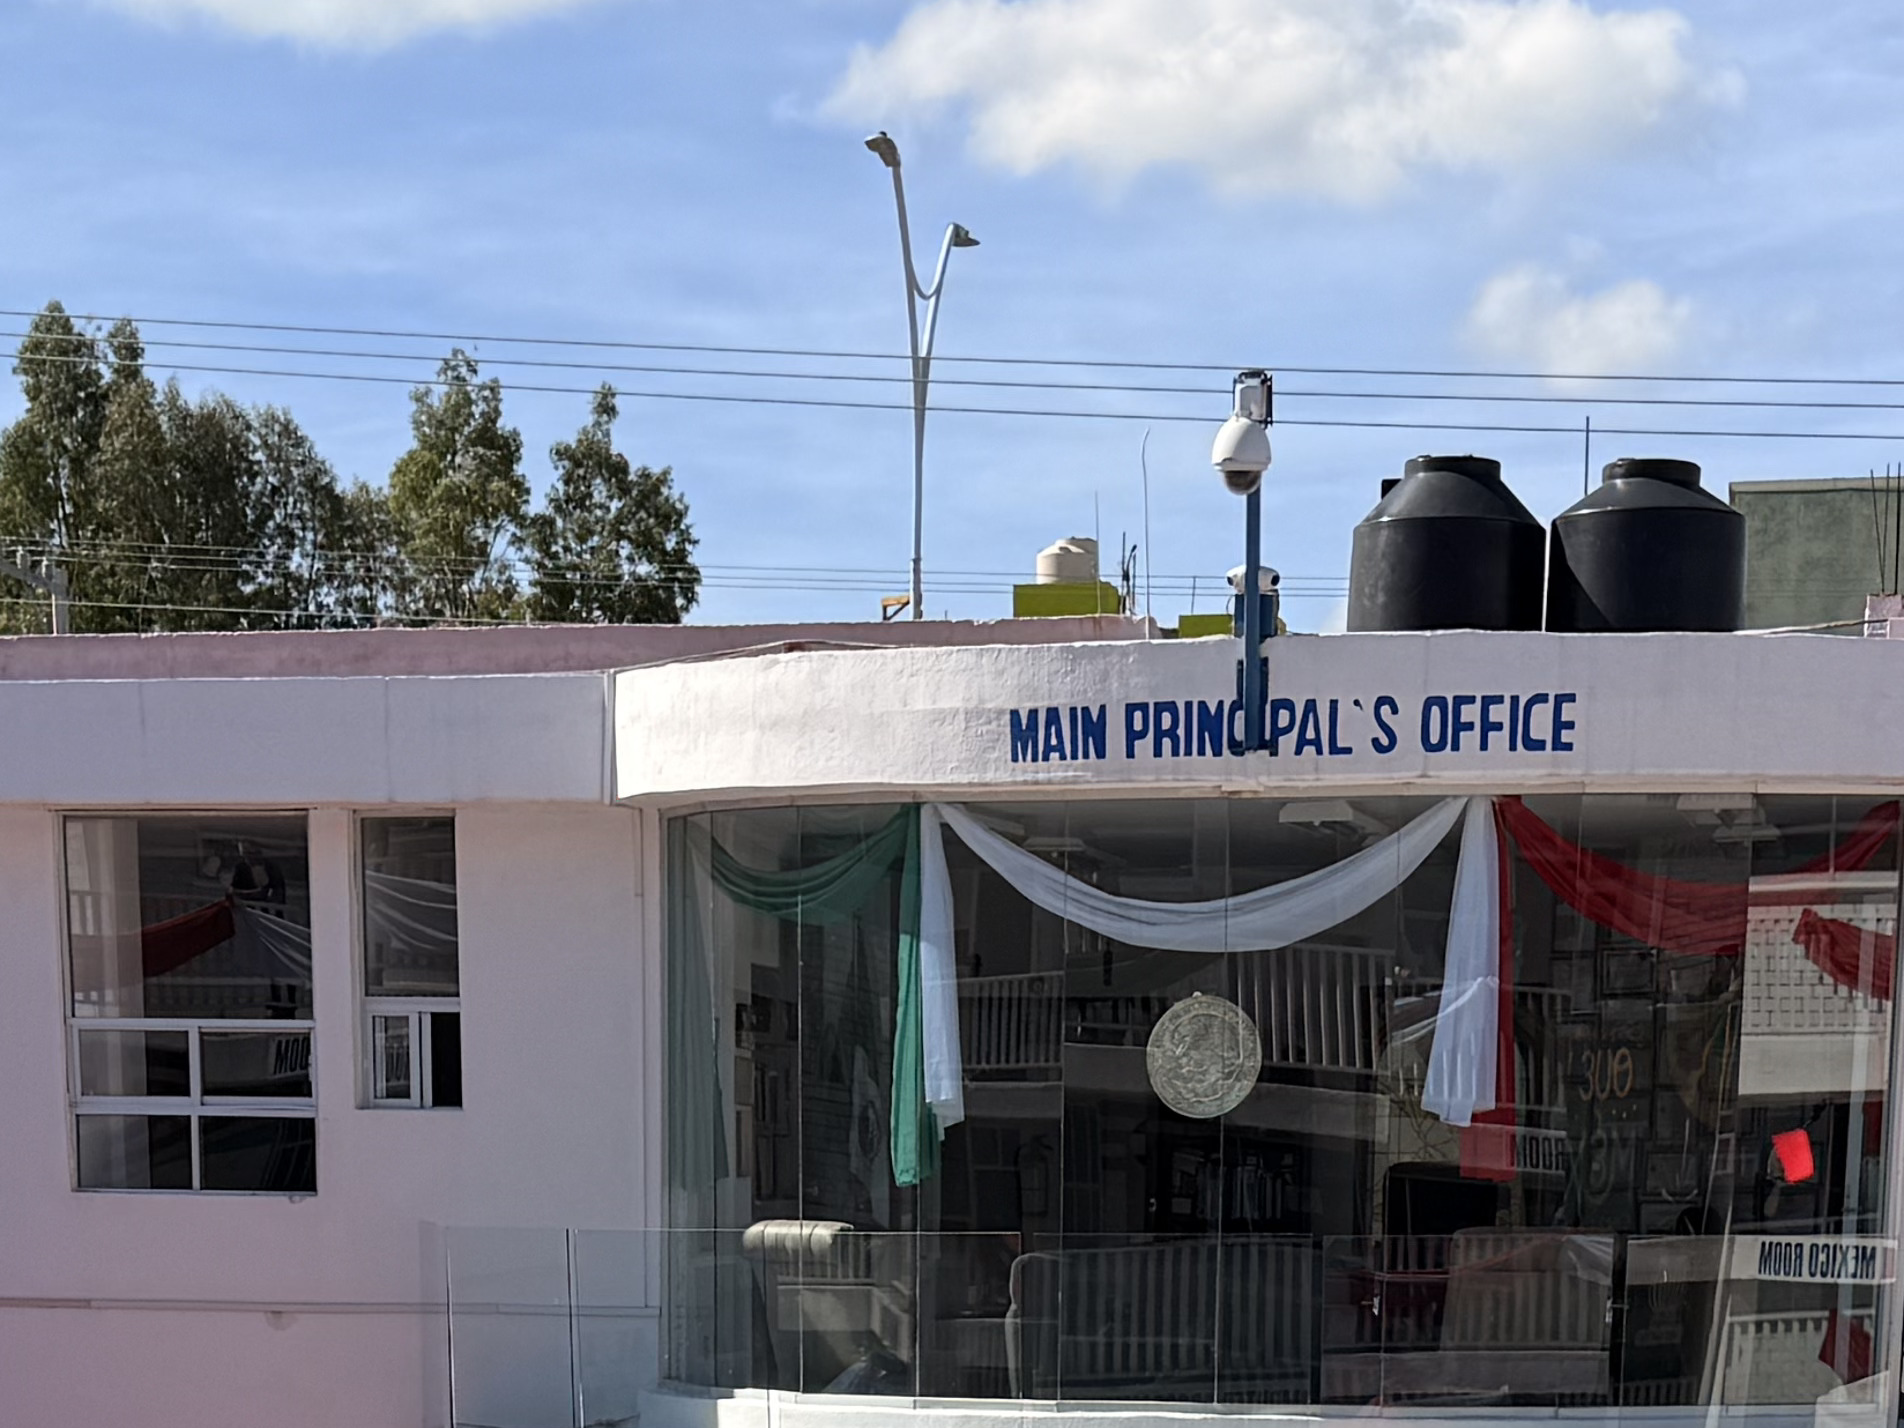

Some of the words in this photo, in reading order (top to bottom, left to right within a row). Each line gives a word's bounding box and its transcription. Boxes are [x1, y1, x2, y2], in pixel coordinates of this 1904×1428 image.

[1009, 704, 1107, 763] MAIN
[1125, 695, 1399, 760] PRINCPAL'S
[1419, 692, 1576, 753] OFFICE
